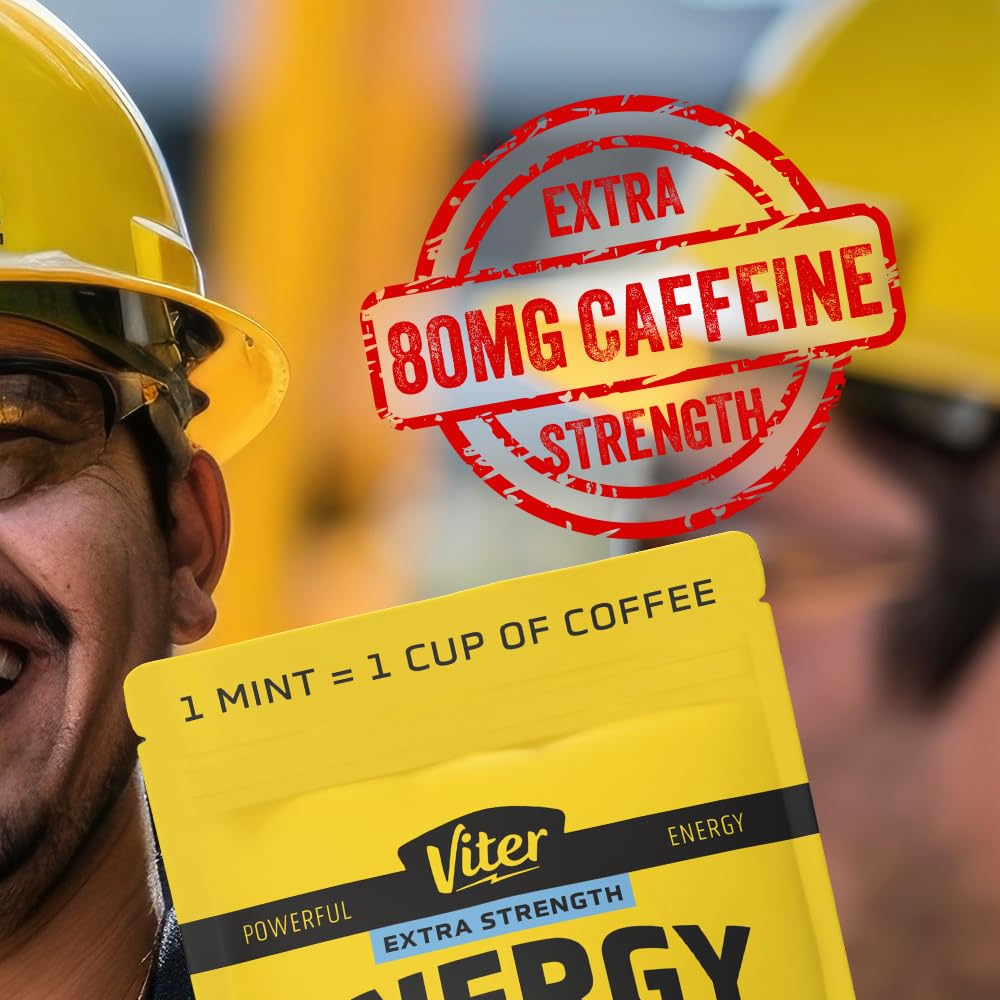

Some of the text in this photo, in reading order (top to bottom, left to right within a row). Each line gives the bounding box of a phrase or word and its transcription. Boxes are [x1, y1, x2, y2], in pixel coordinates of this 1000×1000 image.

[180, 695, 205, 723] 1
[216, 668, 316, 714] MINT
[367, 653, 392, 681] 1
[405, 631, 486, 673] CUP
[499, 616, 551, 650] OF
[565, 578, 717, 637] COFFEE
[425, 824, 549, 895] Viter
[667, 812, 746, 848] ENERGY
[243, 901, 353, 945] POWERFUL
[383, 884, 625, 954] EXTRA STRENGTH
